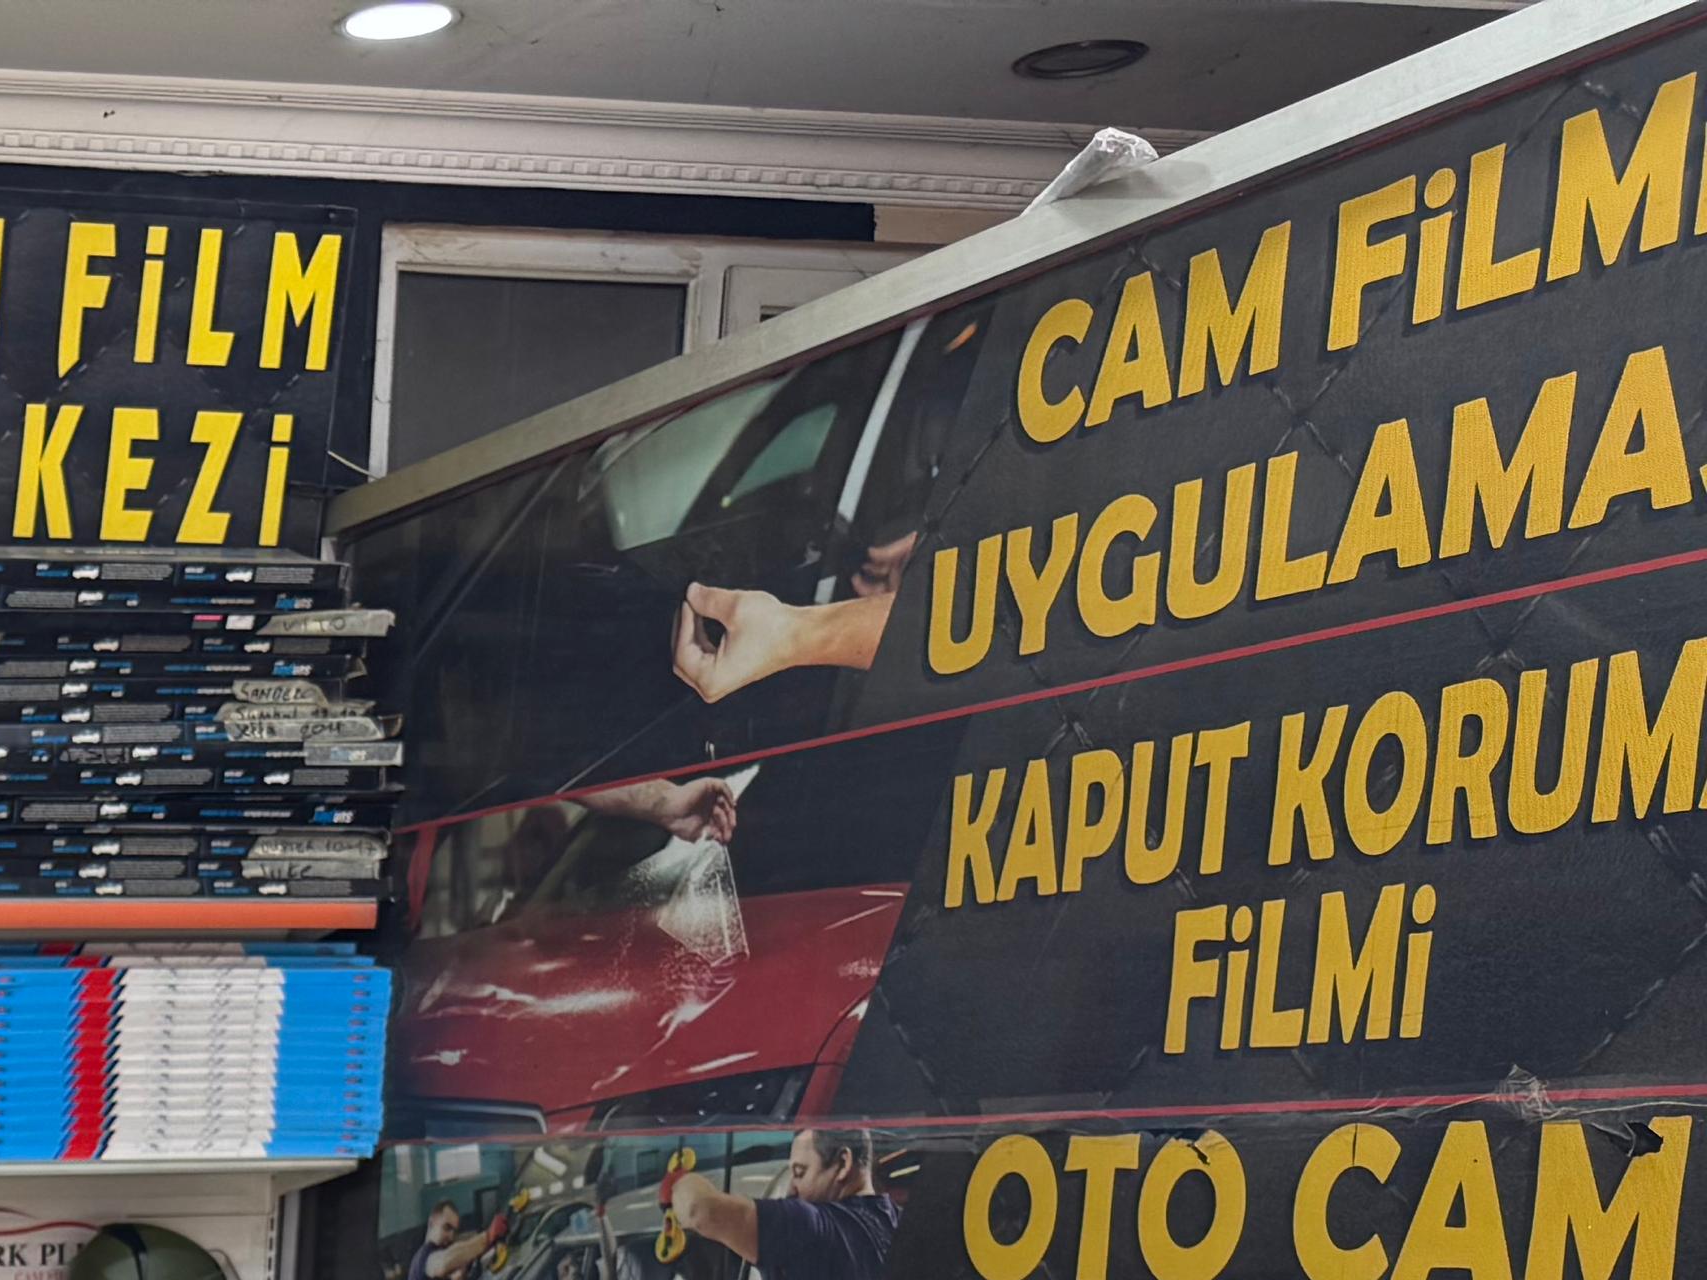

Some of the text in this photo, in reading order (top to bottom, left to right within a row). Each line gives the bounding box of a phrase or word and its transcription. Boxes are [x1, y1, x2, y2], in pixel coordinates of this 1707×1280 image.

[1017, 223, 1292, 443] CAM
[929, 347, 1707, 675] UYGULAMA
[945, 637, 1707, 908] KAPUT KORUM
